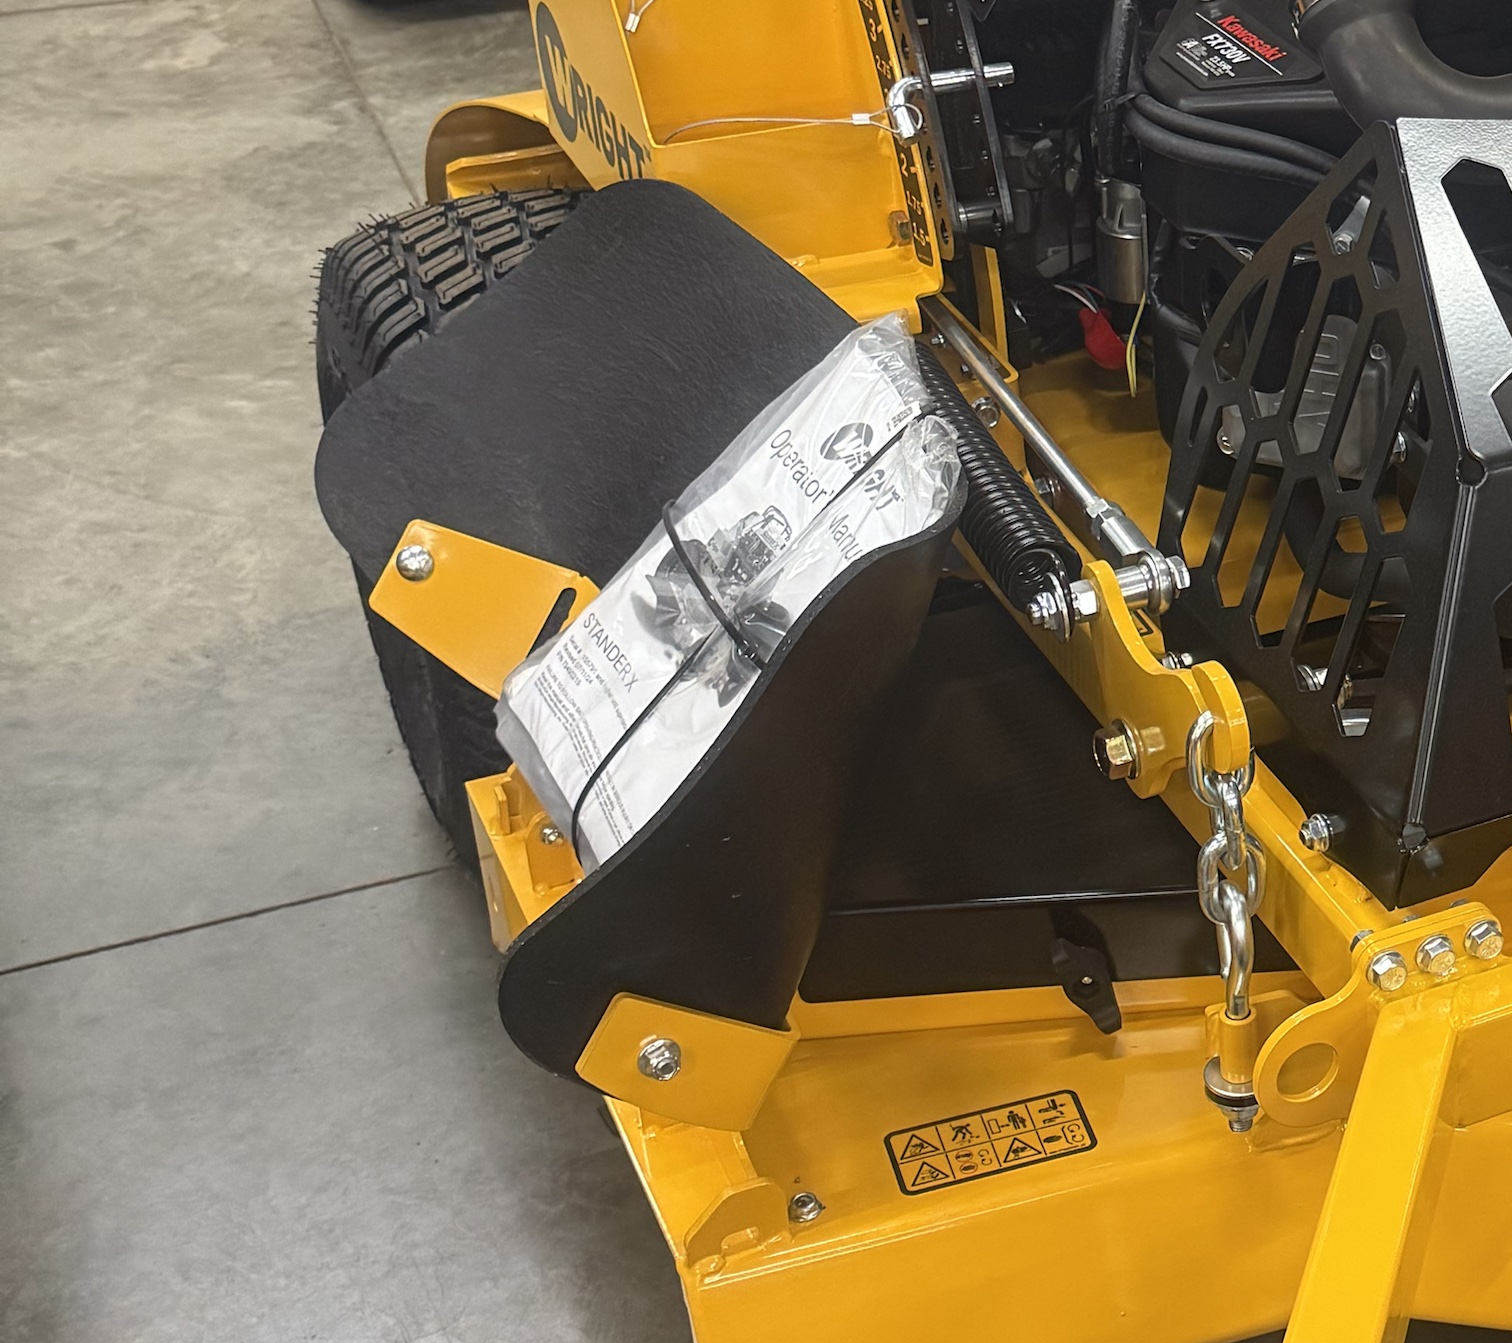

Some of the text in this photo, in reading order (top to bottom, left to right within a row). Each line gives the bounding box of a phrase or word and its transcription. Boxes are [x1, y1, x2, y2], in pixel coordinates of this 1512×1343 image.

[869, 18, 878, 43] 3
[1217, 15, 1288, 63] Kawasaki
[1201, 32, 1251, 66] FX730V
[875, 55, 892, 81] 2.75
[536, 2, 646, 180] WRIGHT
[900, 154, 909, 178] 2
[905, 189, 922, 216] 1.75
[912, 221, 926, 247] 1.5
[820, 422, 905, 512] WRGHT
[769, 429, 864, 563] Operator' Manu
[583, 612, 640, 694] STANDER X
